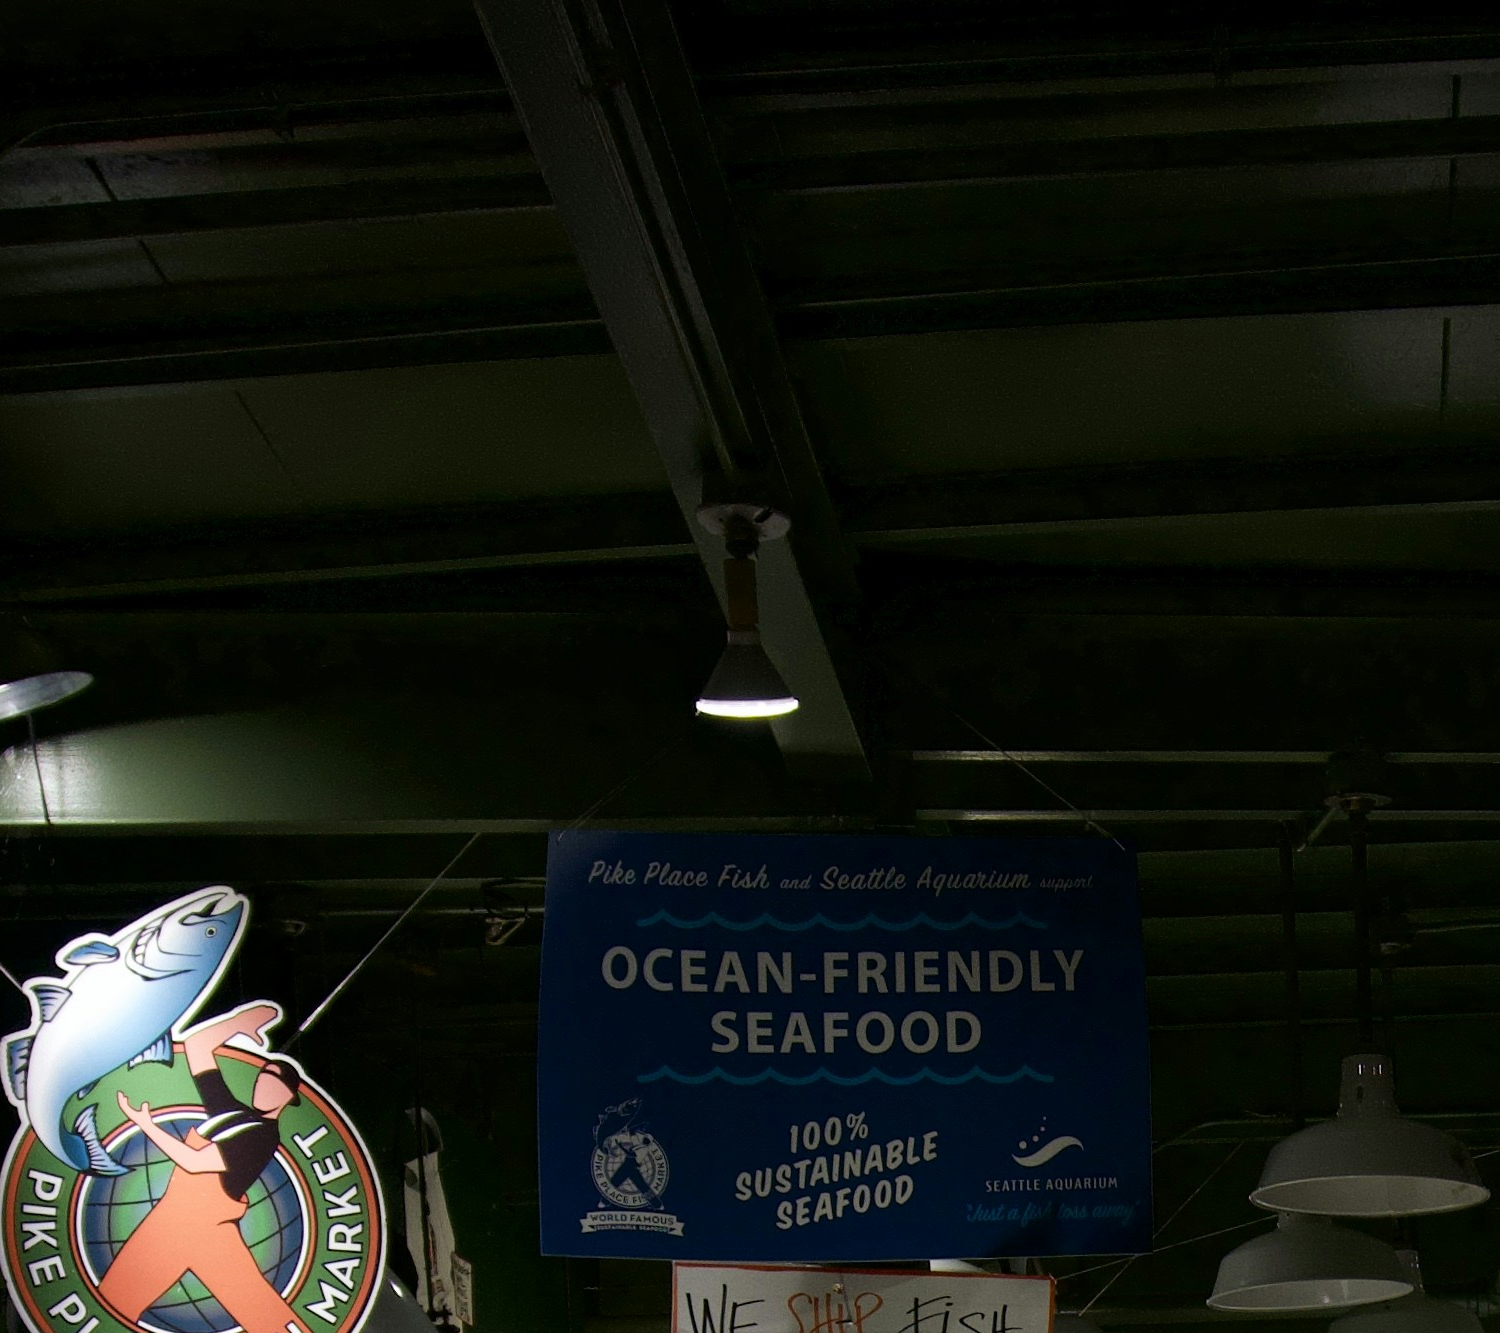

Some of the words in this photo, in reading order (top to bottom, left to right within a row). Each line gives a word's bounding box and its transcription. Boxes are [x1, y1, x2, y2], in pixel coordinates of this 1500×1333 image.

[588, 859, 638, 889] Pike
[643, 862, 709, 889] Place
[717, 862, 770, 891] Fish
[780, 873, 811, 891] and
[819, 865, 907, 892] Seattle
[916, 866, 1031, 899] Aquarium
[1039, 874, 1093, 893] support
[601, 944, 1085, 994] OCEAN-FRIENDLY
[710, 1009, 983, 1056] SEAFOOD
[789, 1110, 869, 1153] 100%
[594, 1154, 605, 1179] PIKE
[600, 1181, 630, 1204] PLACE
[734, 1130, 940, 1202] SUSTAINABLE
[985, 1178, 1041, 1193] SEATTLE
[1045, 1176, 1119, 1192] AQUARIUM
[25, 1167, 68, 1287] PIKE
[291, 1123, 366, 1327] MARKET
[590, 1213, 627, 1222] WORLD
[629, 1214, 675, 1226] FAMOUS
[775, 1174, 915, 1232] SEAFOOD
[1007, 1207, 1020, 1221] a
[1057, 1203, 1089, 1219] toss
